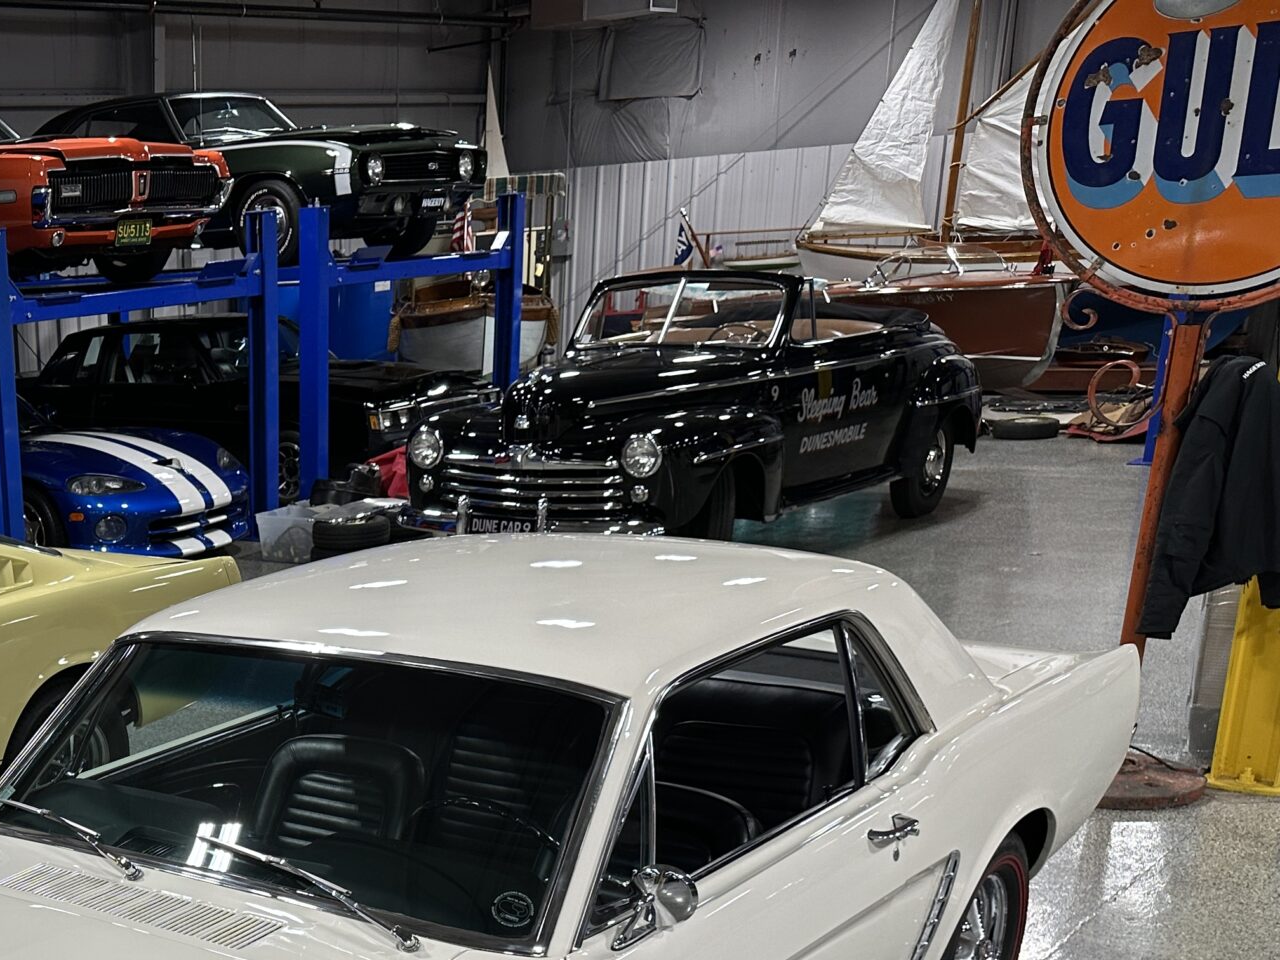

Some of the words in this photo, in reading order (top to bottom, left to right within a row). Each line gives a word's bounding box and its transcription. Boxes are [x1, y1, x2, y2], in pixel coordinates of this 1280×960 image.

[771, 385, 779, 401] 9
[797, 387, 846, 422] Sleeping
[849, 378, 878, 410] Bear
[800, 423, 868, 454] DUNESMOBILE
[471, 518, 499, 533] DUNE
[500, 520, 522, 533] CAR
